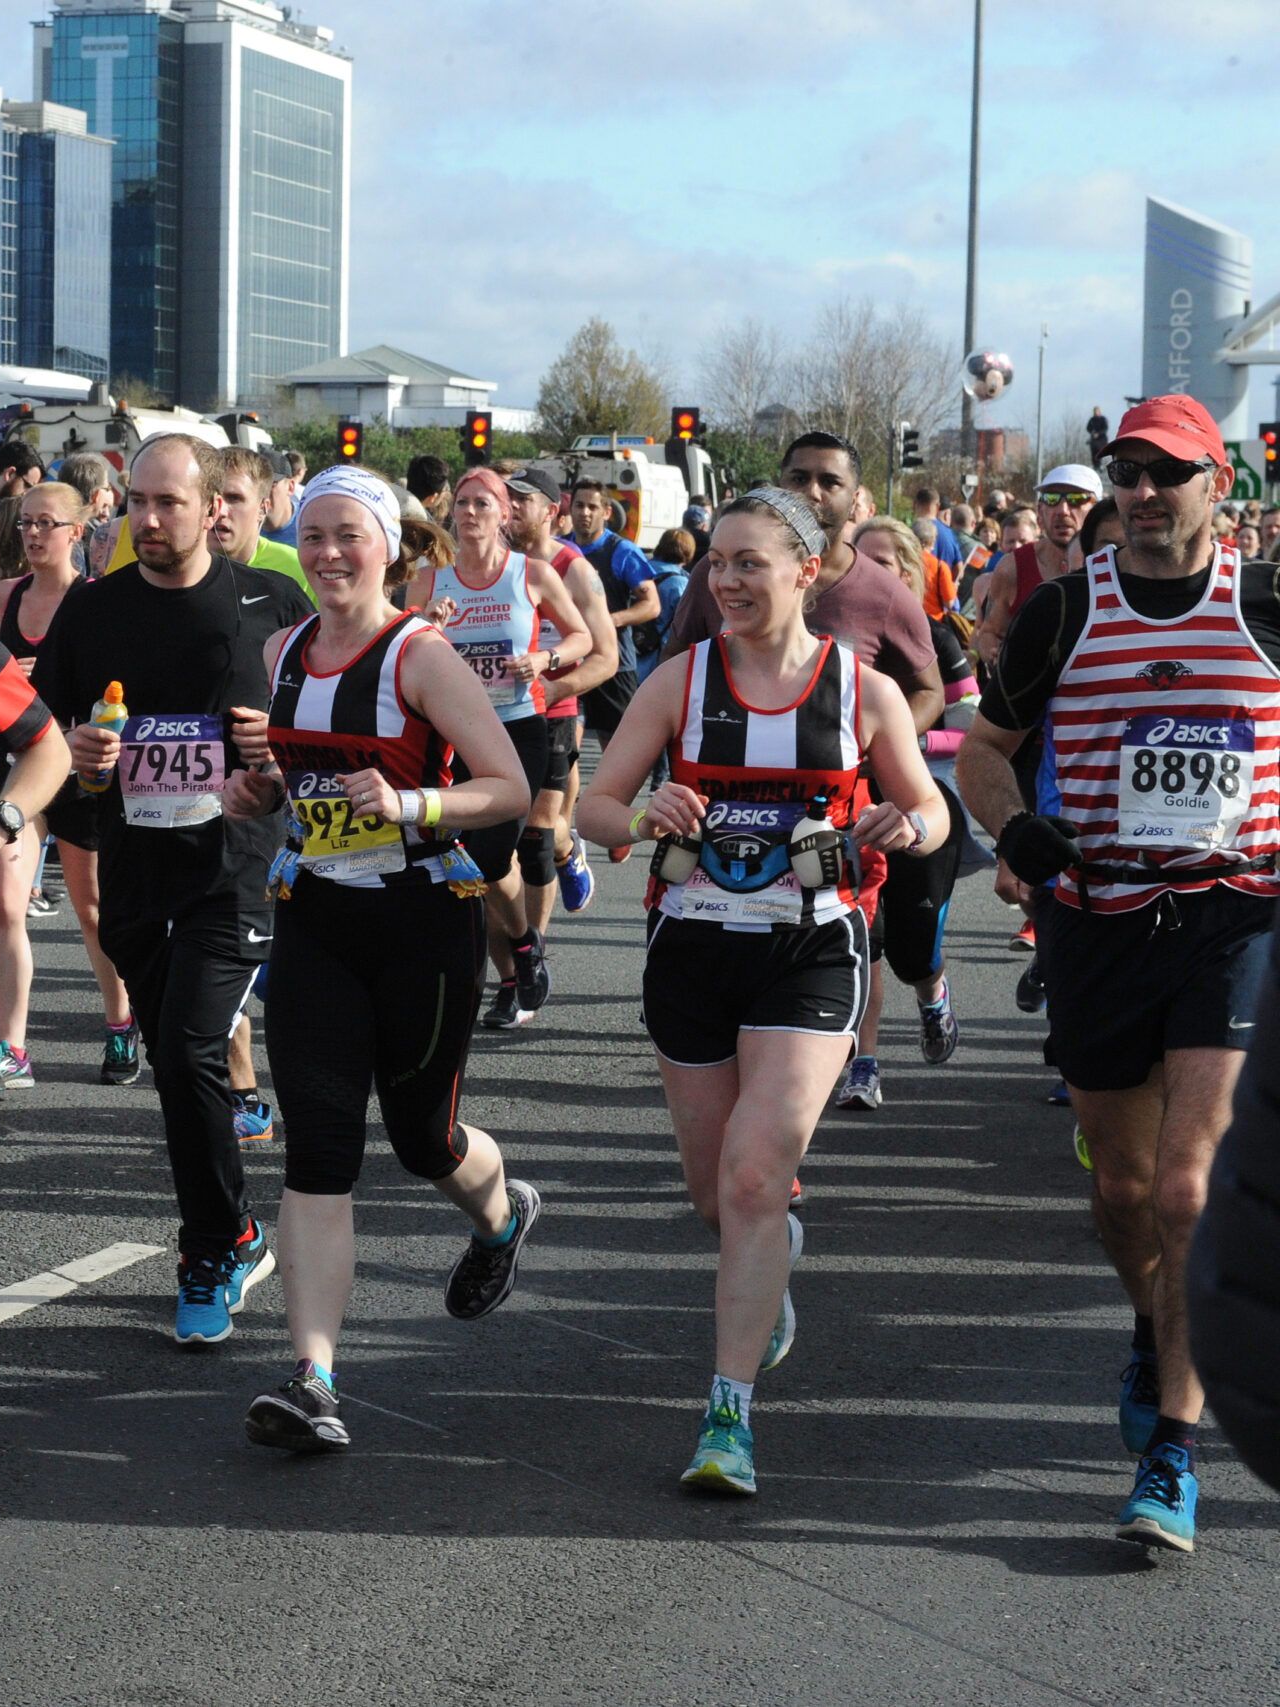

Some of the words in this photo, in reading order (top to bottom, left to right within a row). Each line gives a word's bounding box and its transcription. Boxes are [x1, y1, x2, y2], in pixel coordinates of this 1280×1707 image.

[461, 596, 496, 604] CHERYL
[453, 624, 482, 632] RUNNING
[126, 744, 213, 782] 7945
[1132, 749, 1240, 798] 8898
[128, 783, 154, 793] John
[157, 783, 177, 792] The
[182, 782, 214, 792] Pirate
[1164, 795, 1210, 809] Goldie
[331, 838, 350, 850] Liz
